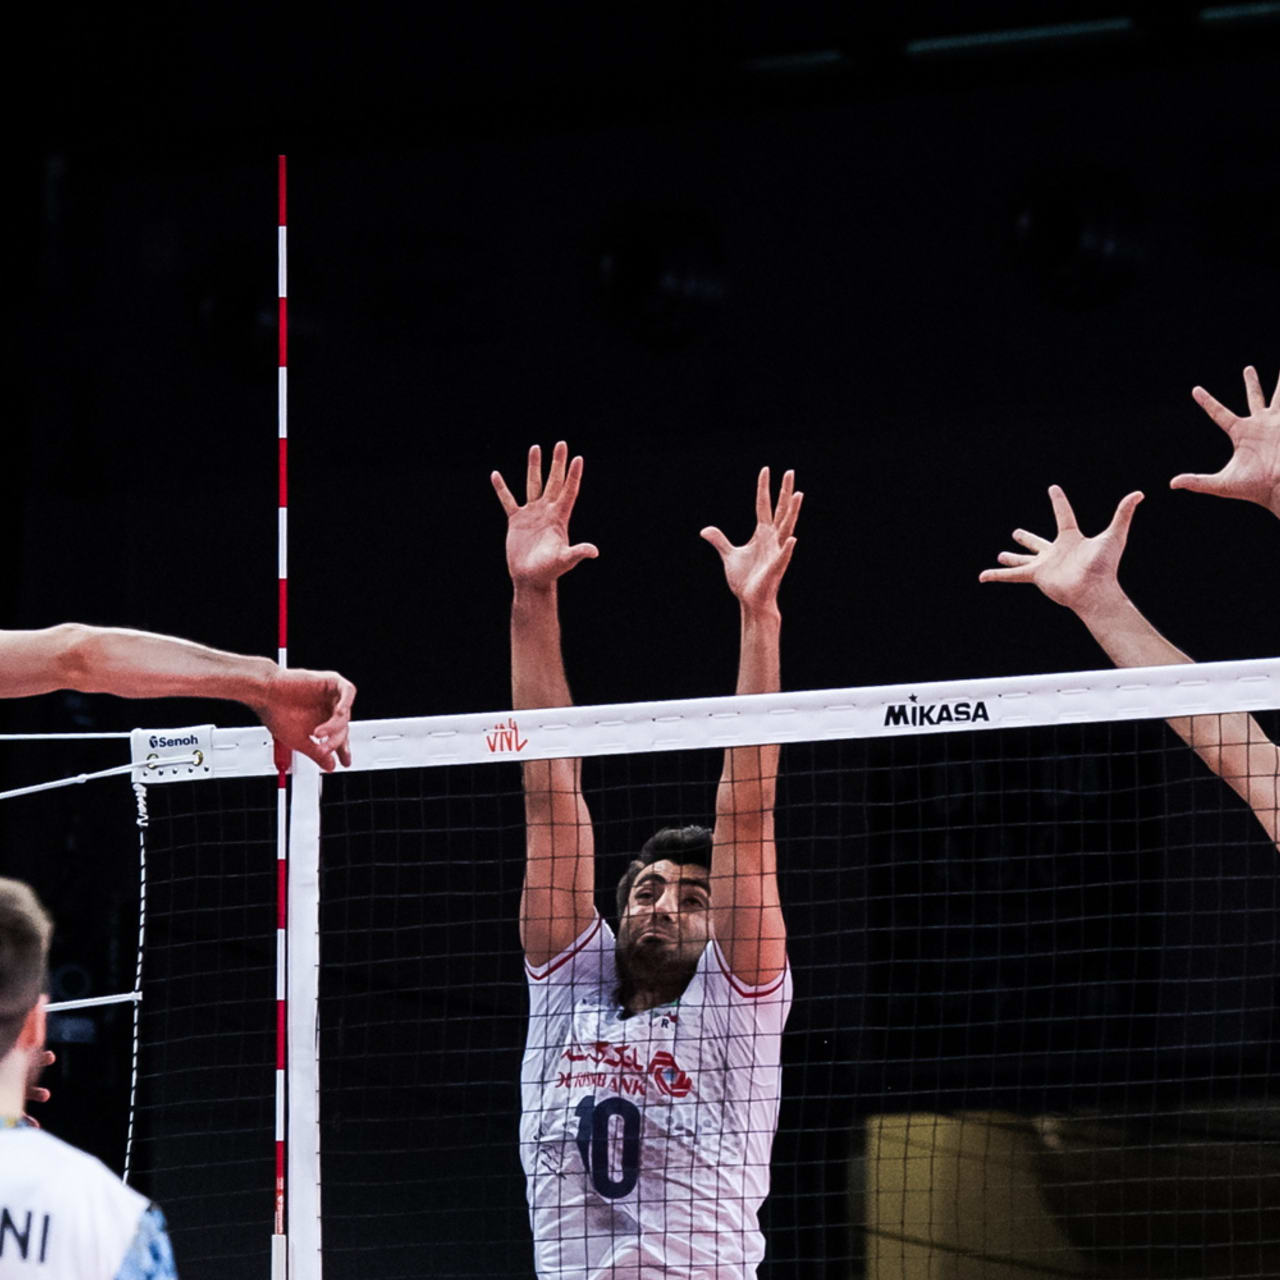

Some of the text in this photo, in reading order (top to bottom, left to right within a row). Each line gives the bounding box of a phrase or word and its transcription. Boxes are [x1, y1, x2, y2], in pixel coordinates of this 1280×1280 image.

[884, 694, 990, 727] MIKASA
[159, 734, 199, 748] Senoh
[486, 718, 528, 752] VNL
[575, 1095, 641, 1200] 10
